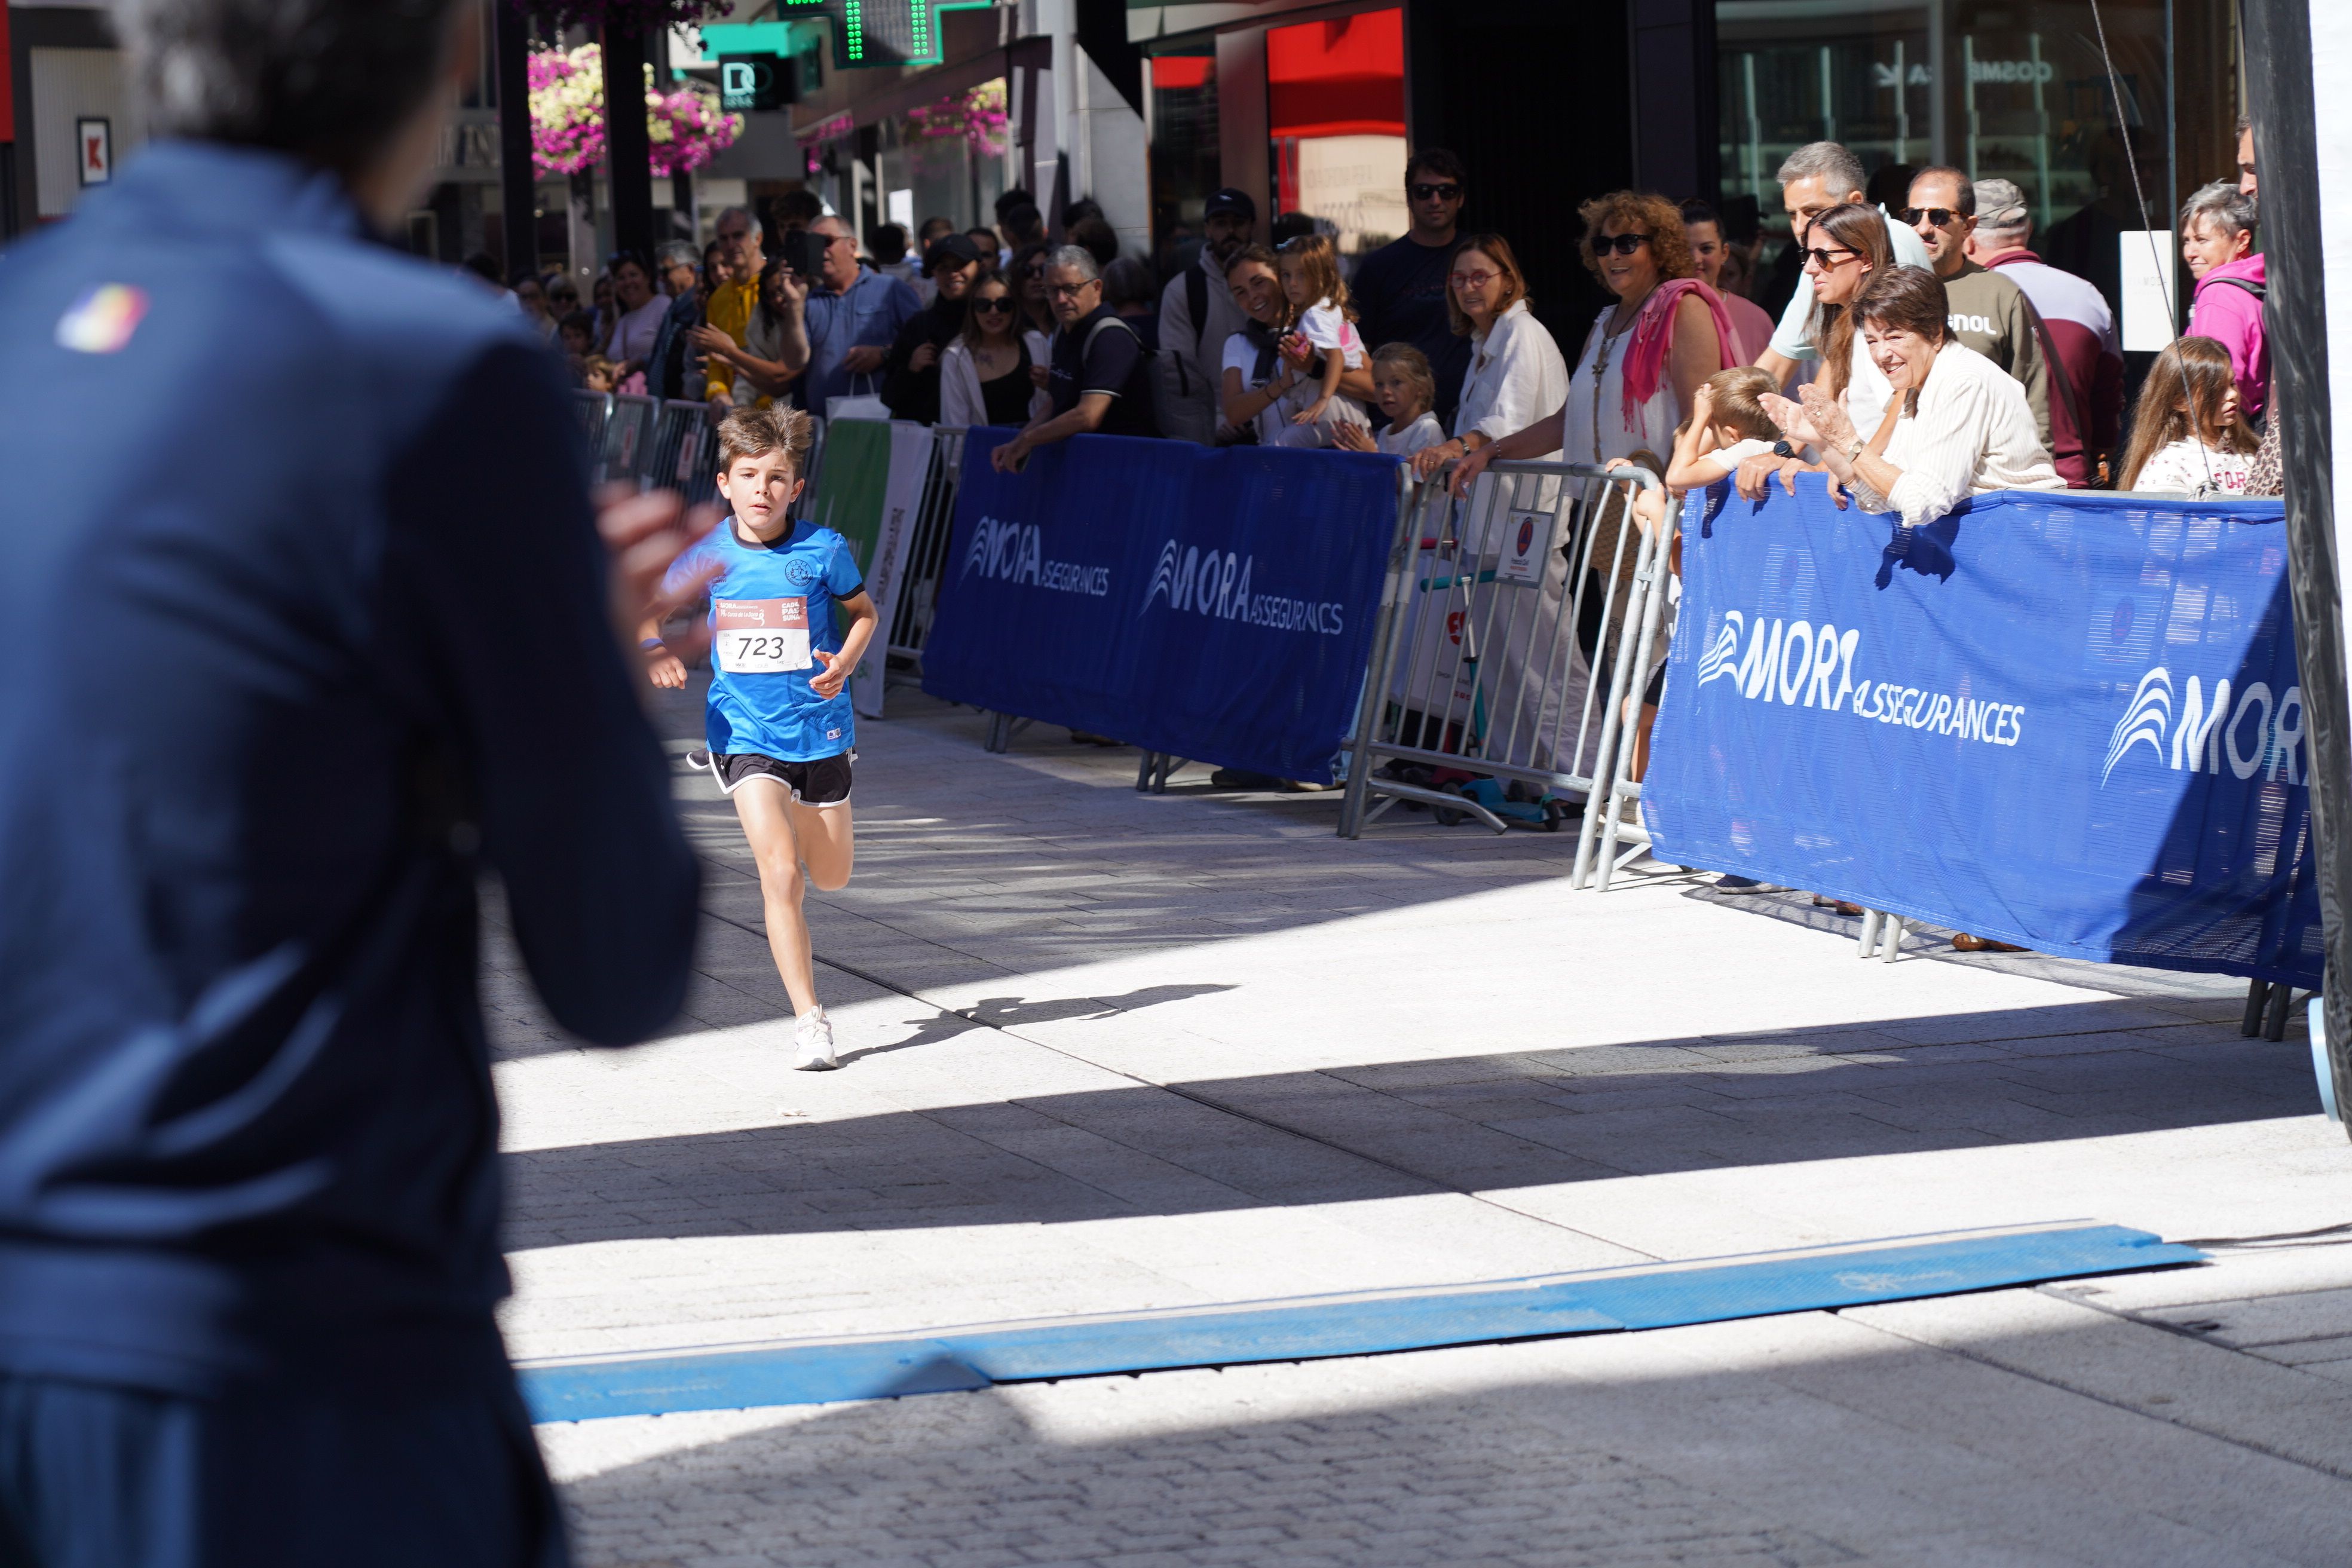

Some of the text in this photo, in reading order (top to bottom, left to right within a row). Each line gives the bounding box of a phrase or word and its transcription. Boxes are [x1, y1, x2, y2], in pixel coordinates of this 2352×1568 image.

[87, 136, 103, 170] K
[738, 636, 784, 660] 723
[2170, 675, 2310, 786] MOR
